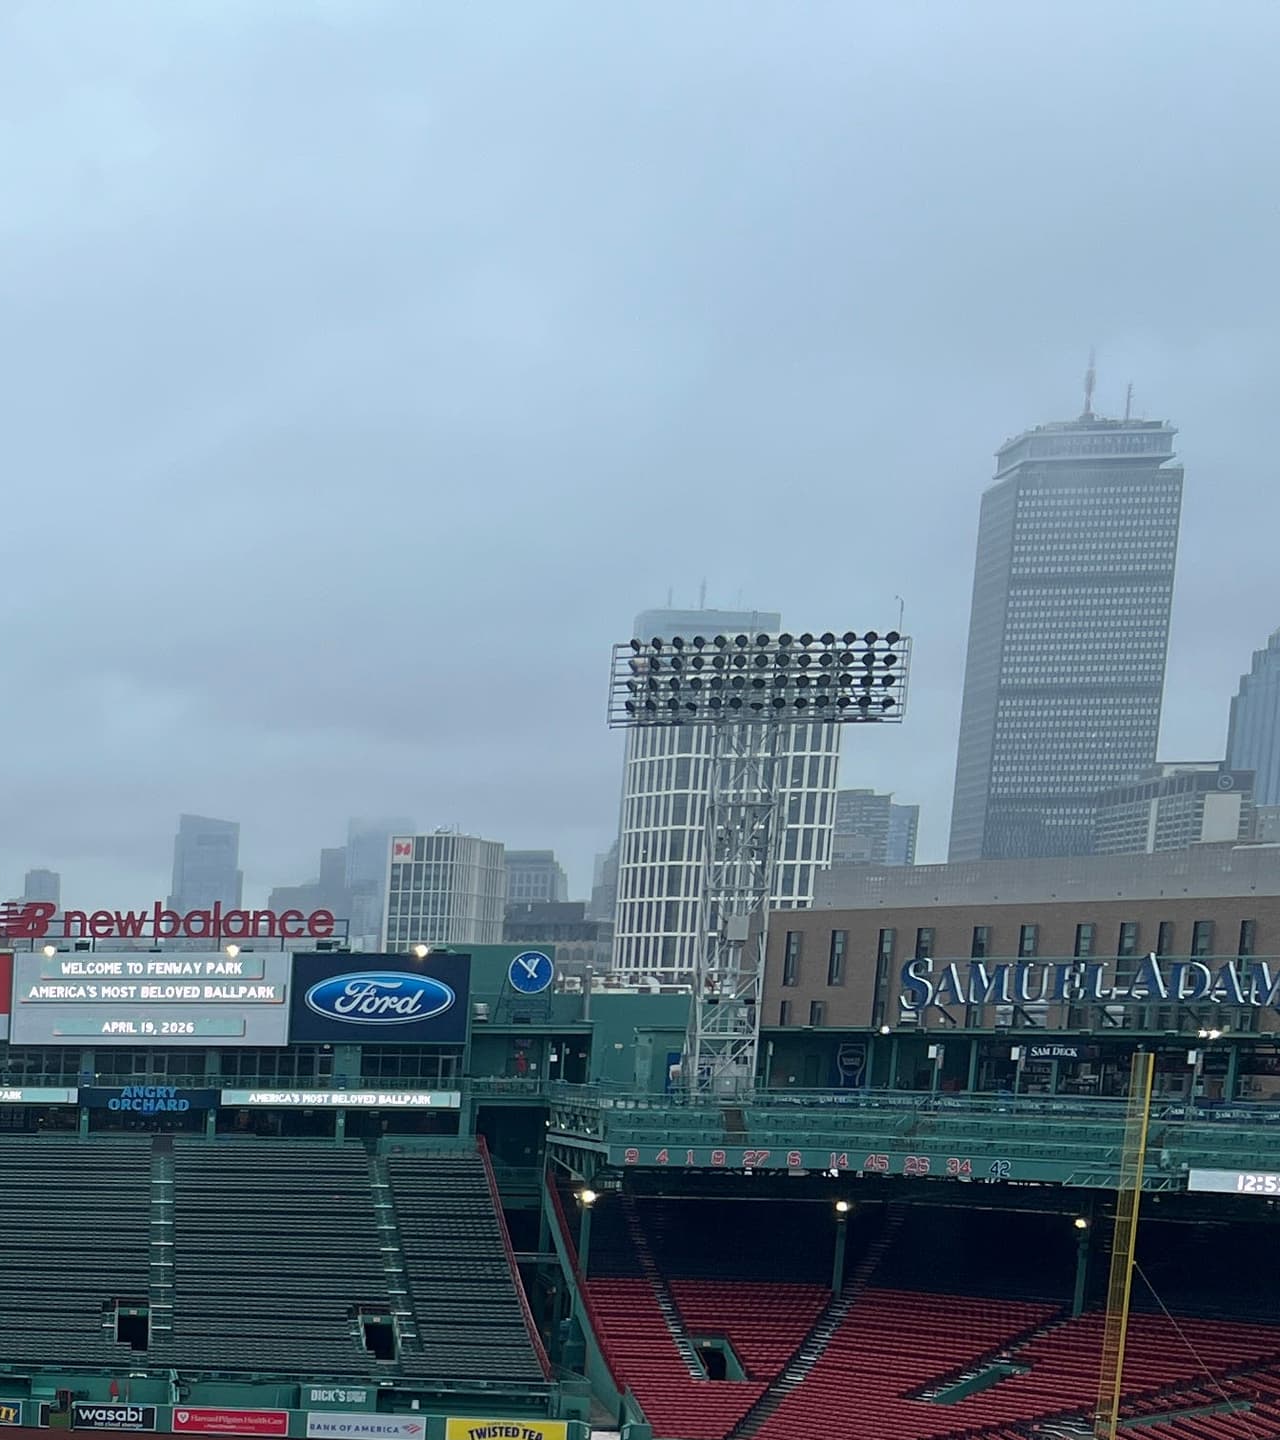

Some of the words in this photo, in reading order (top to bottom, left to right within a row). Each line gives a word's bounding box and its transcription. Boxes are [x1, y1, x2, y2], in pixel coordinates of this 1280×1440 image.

[63, 909, 147, 938] new
[153, 900, 335, 938] balance
[61, 962, 122, 975] WELCOME
[127, 962, 143, 974] TO
[147, 962, 202, 975] FENWAY
[206, 961, 242, 975] PARK
[898, 957, 1117, 1011] SAMUEL
[29, 985, 98, 999] AMERICA'S
[101, 985, 137, 998] MOST
[141, 985, 201, 998] BELOVED
[204, 985, 275, 999] BALLPARK
[334, 979, 425, 1014] Ford
[102, 1022, 137, 1034] APRIL
[161, 1022, 194, 1034] 2026
[120, 1086, 177, 1098] ANGRY
[108, 1098, 189, 1111] ORCHARD
[303, 1094, 329, 1104] MOST
[332, 1094, 376, 1105] BELOVED
[379, 1094, 431, 1105] BALLPARK
[656, 1149, 668, 1164] 4
[686, 1149, 694, 1165] 1
[742, 1150, 769, 1167] 27
[946, 1158, 972, 1175] 34
[989, 1160, 1011, 1177] 42
[311, 1389, 345, 1402] DICK'S
[78, 1407, 143, 1422] wasabi
[310, 1423, 337, 1431] BANK
[353, 1424, 400, 1434] AMERICA
